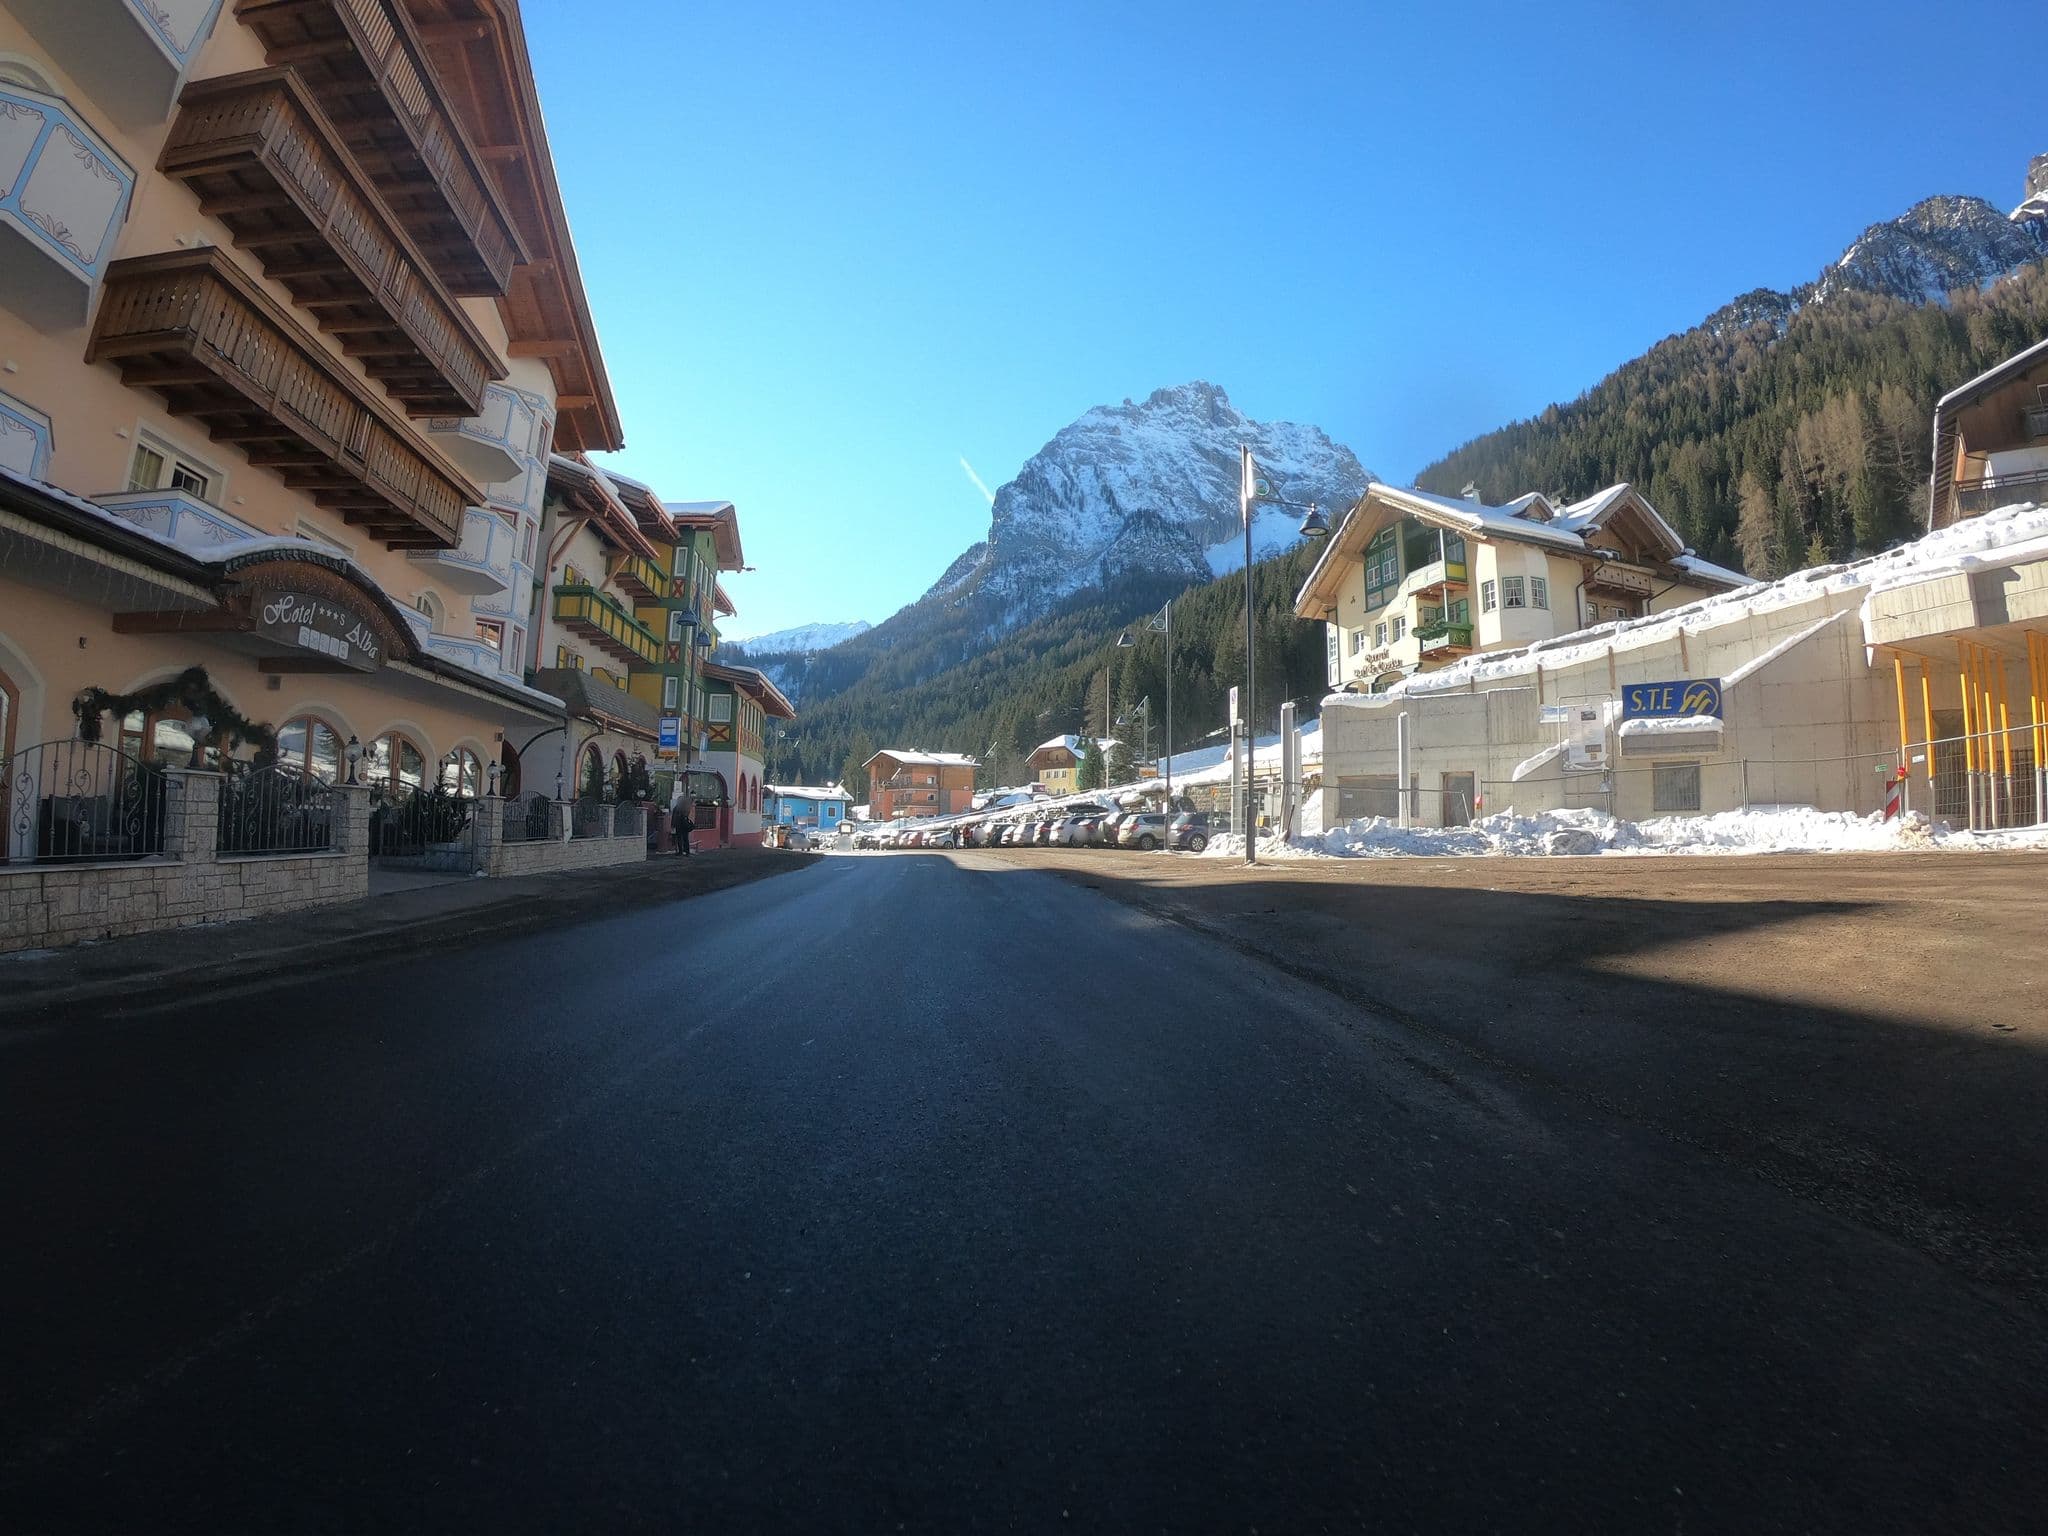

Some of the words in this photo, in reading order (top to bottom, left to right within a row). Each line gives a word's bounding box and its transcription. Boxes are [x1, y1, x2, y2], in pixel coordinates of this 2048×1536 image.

[263, 595, 316, 625] Hotel
[344, 621, 379, 659] Alba
[1630, 687, 1674, 712] S.T.E
